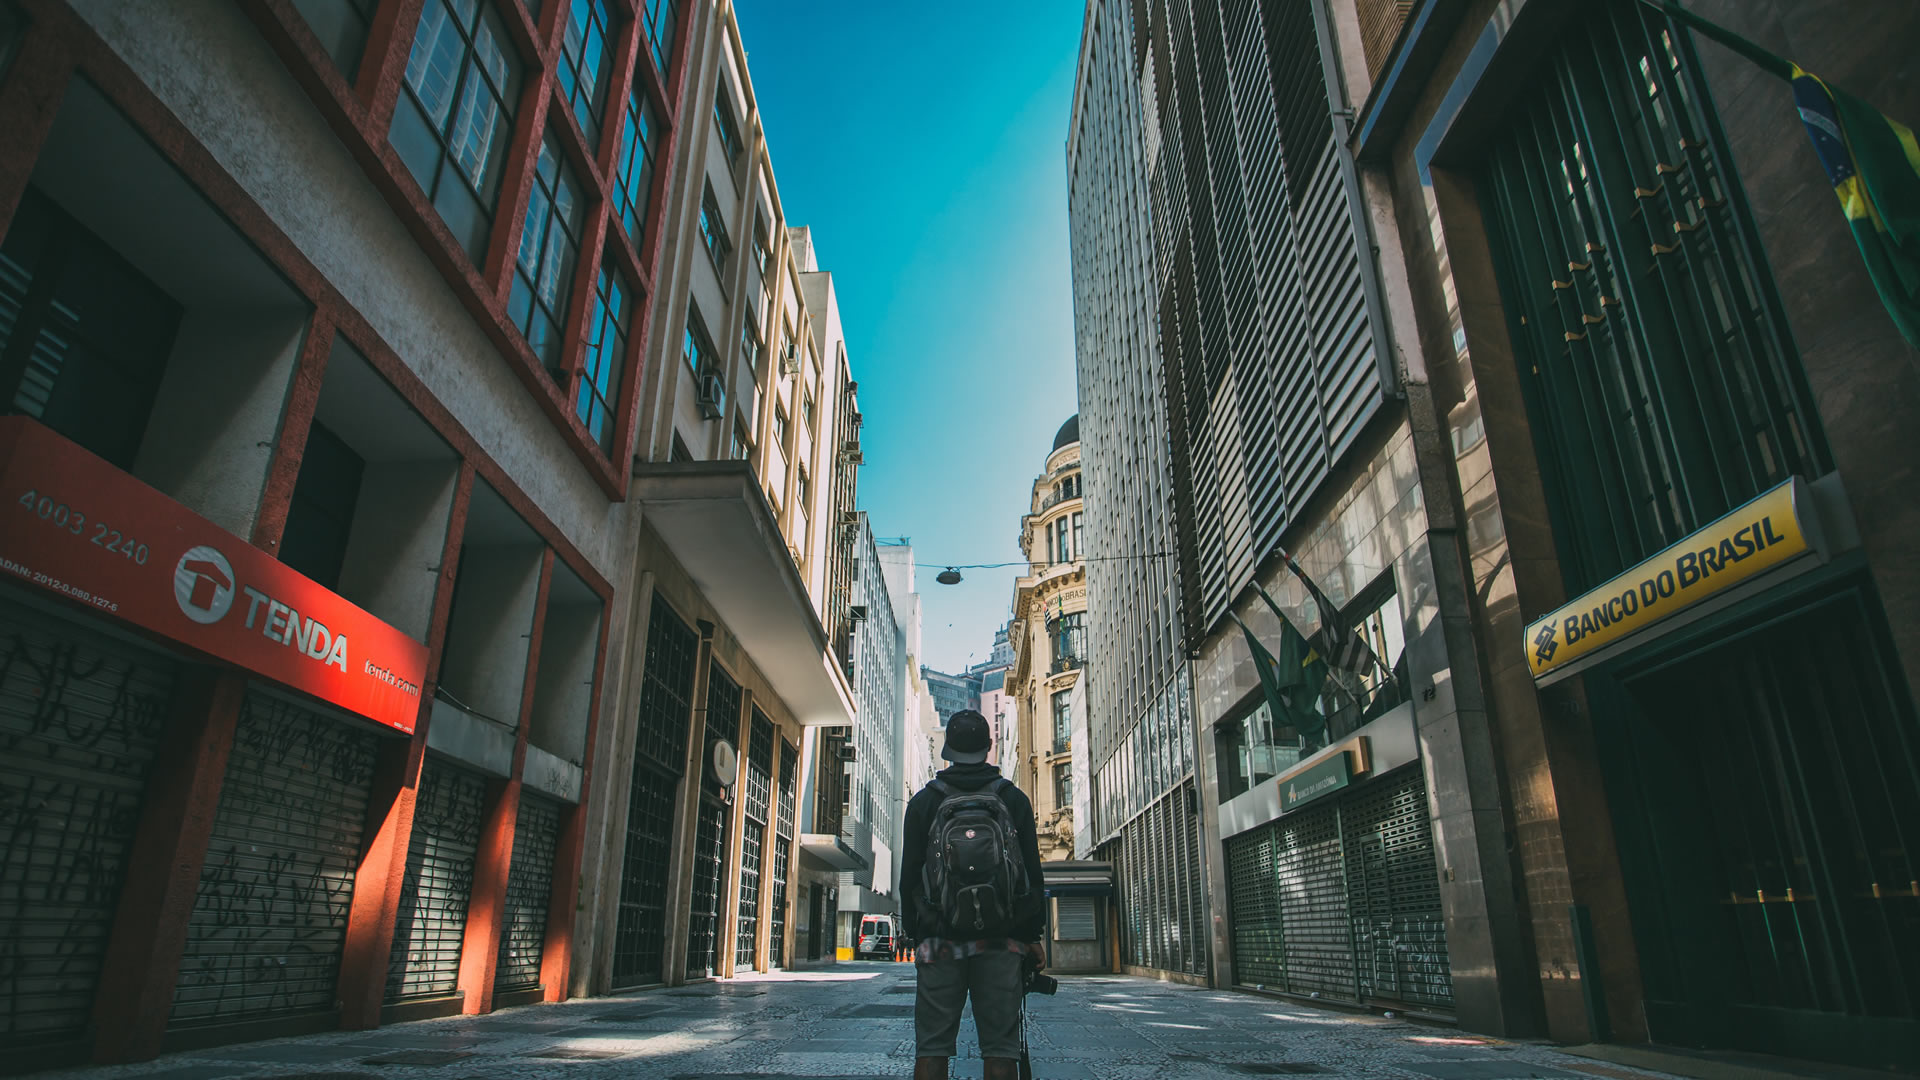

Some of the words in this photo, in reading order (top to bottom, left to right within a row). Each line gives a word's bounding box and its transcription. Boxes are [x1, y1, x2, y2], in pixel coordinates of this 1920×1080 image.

[18, 488, 87, 535] 4003
[90, 523, 151, 566] 2240
[1065, 589, 1086, 601] BRASI
[1563, 588, 1638, 646] BANCO
[1639, 569, 1675, 608] DO
[1676, 516, 1785, 590] BRASIL
[243, 584, 348, 673] TENDA
[364, 658, 419, 697] tenda.com
